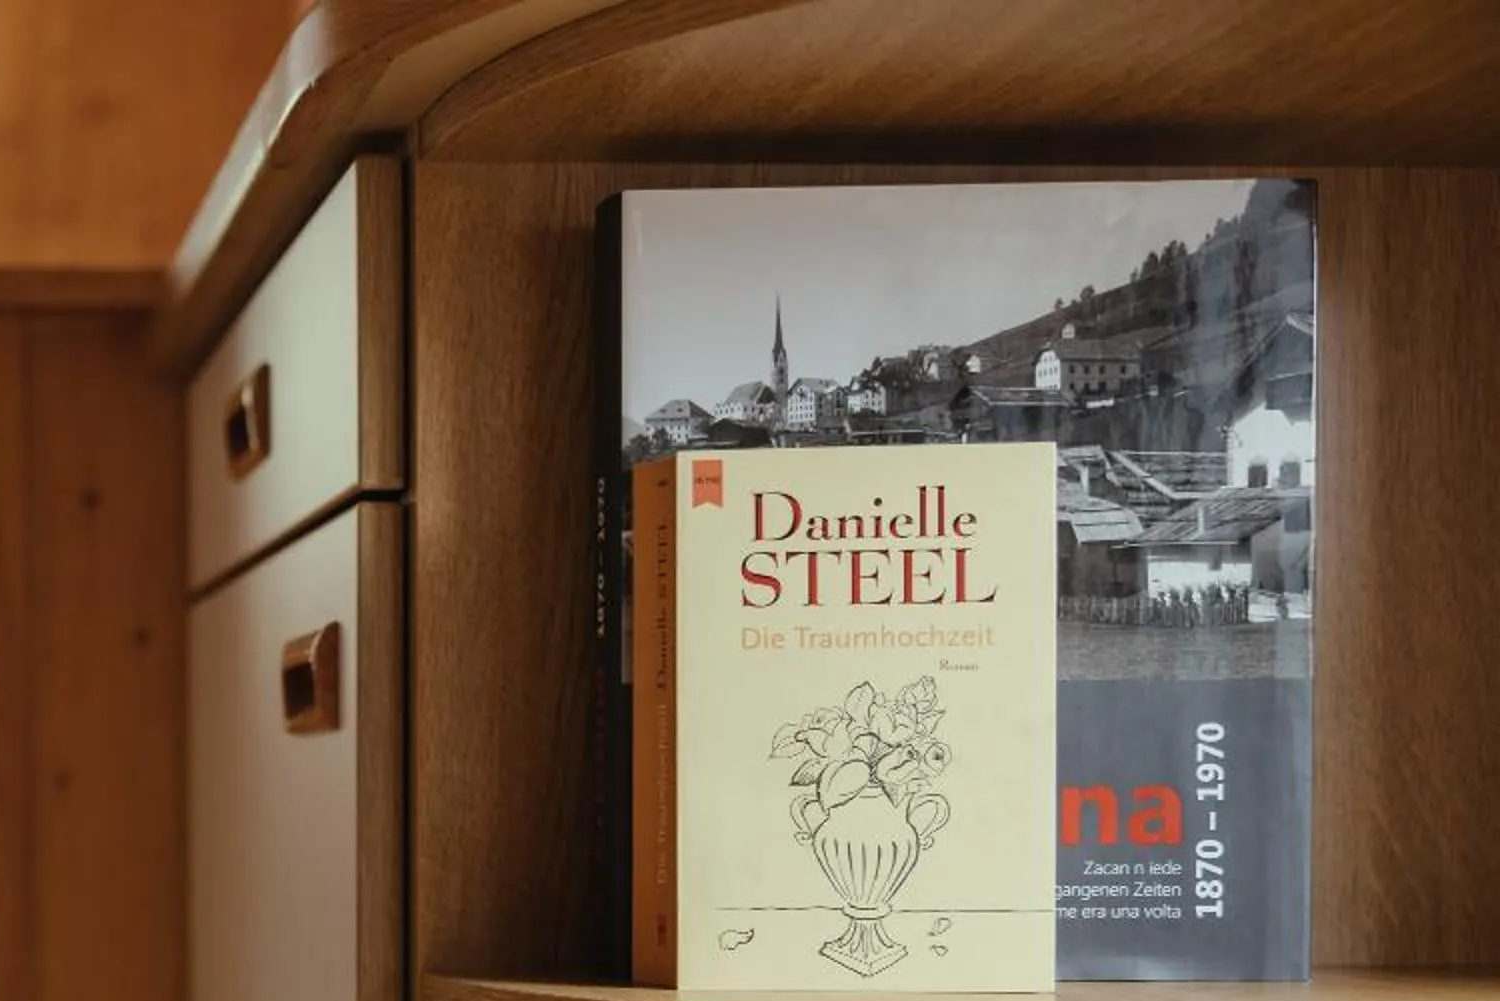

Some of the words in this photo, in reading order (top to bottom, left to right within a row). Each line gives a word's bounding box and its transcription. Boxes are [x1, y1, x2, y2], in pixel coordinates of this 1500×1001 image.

[752, 485, 978, 541] Danielle
[740, 547, 999, 609] STEEL
[740, 626, 786, 650] Die
[793, 622, 996, 649] Traumhochzeit
[1195, 721, 1226, 801] 1970
[1059, 782, 1185, 847] na
[1083, 860, 1131, 875] Zacan
[1133, 862, 1145, 875] n
[1148, 859, 1183, 875] iede
[1132, 881, 1182, 897] Zeiten
[1195, 839, 1225, 919] 1870
[1081, 906, 1107, 919] era
[1110, 906, 1140, 919] una
[1143, 903, 1181, 919] volta
